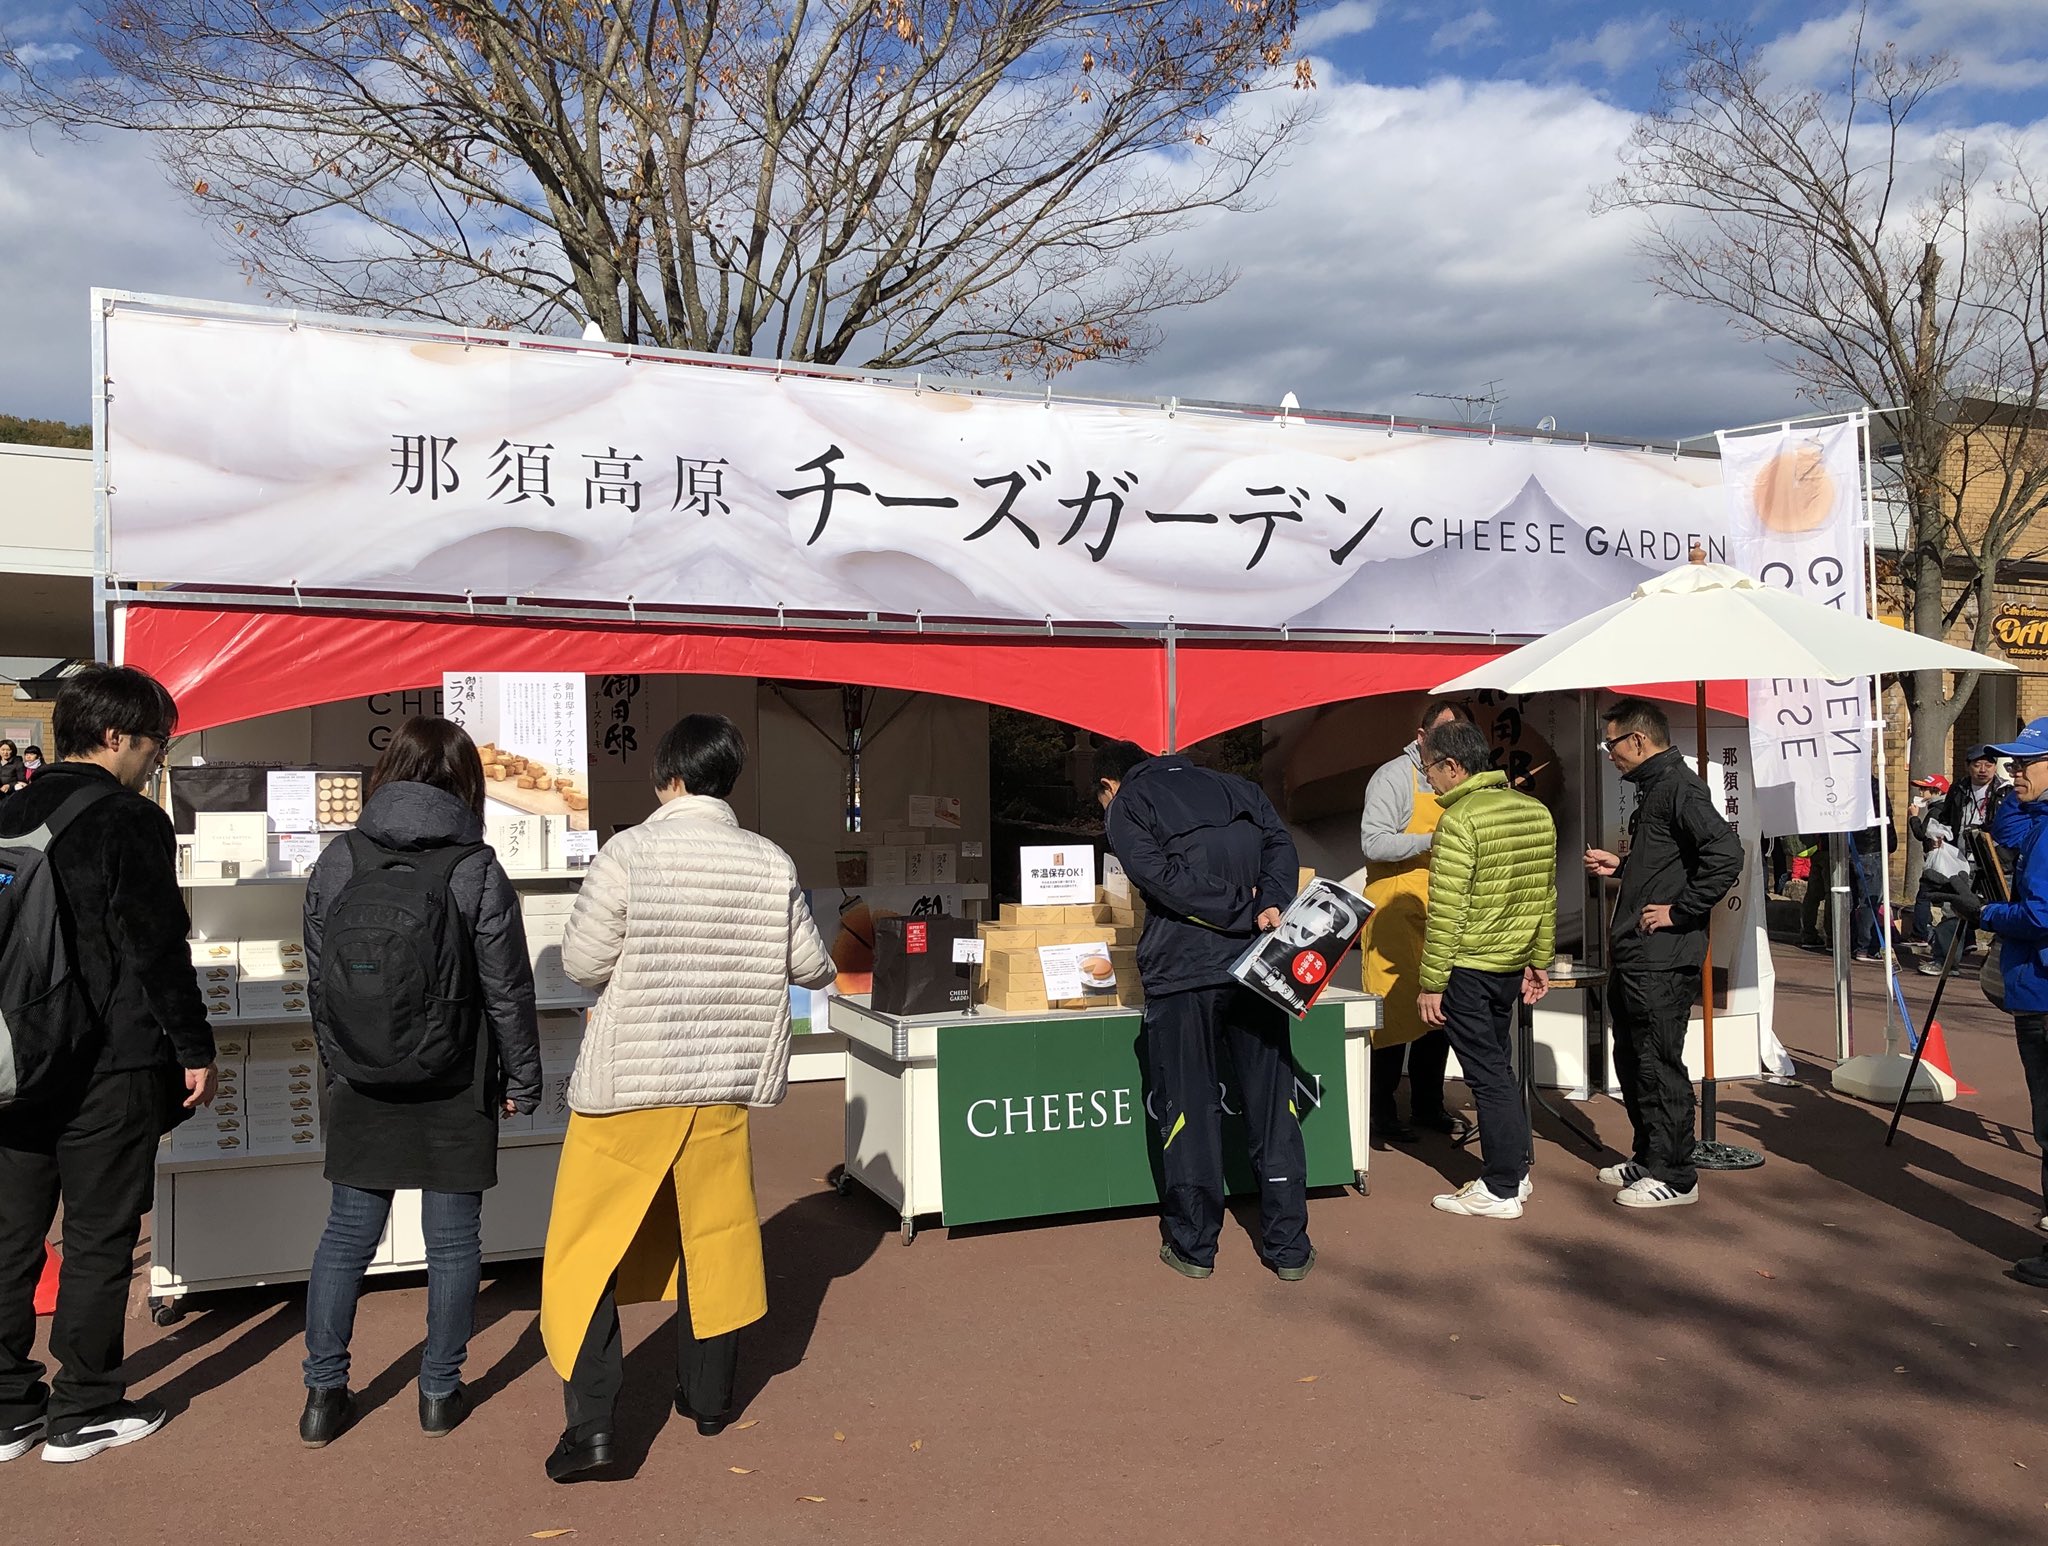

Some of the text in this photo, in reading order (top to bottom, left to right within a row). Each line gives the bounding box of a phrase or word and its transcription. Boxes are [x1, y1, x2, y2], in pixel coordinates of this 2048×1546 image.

[389, 433, 1384, 571] 那須高原 チーズガーデン
[1410, 516, 1727, 563] CHEESE GARDEN
[564, 681, 576, 777] 御用邸チーズケーキを
[592, 691, 601, 749] チーズケーキ
[508, 823, 520, 858] ラスク
[1030, 867, 1084, 879] 常温保存OK!
[554, 1079, 566, 1115] ラスク
[966, 1088, 1132, 1138] CHEESE
